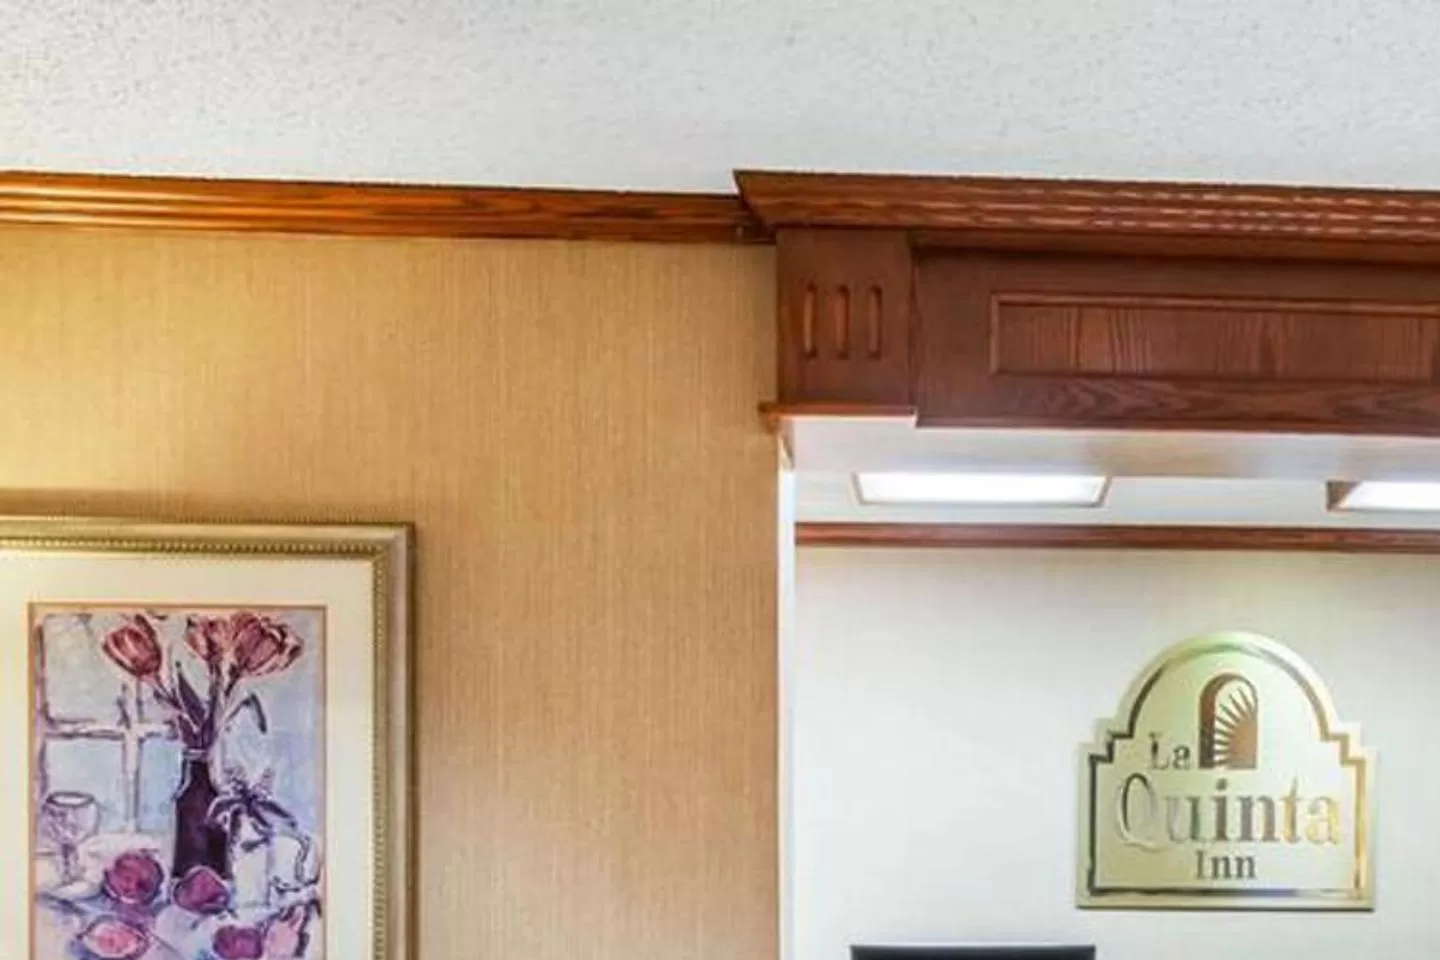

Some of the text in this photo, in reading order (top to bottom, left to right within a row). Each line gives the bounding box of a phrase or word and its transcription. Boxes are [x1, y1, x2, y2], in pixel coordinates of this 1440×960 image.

[1148, 731, 1191, 770] La
[1115, 772, 1341, 852] Quinta
[1195, 850, 1258, 880] Inn
